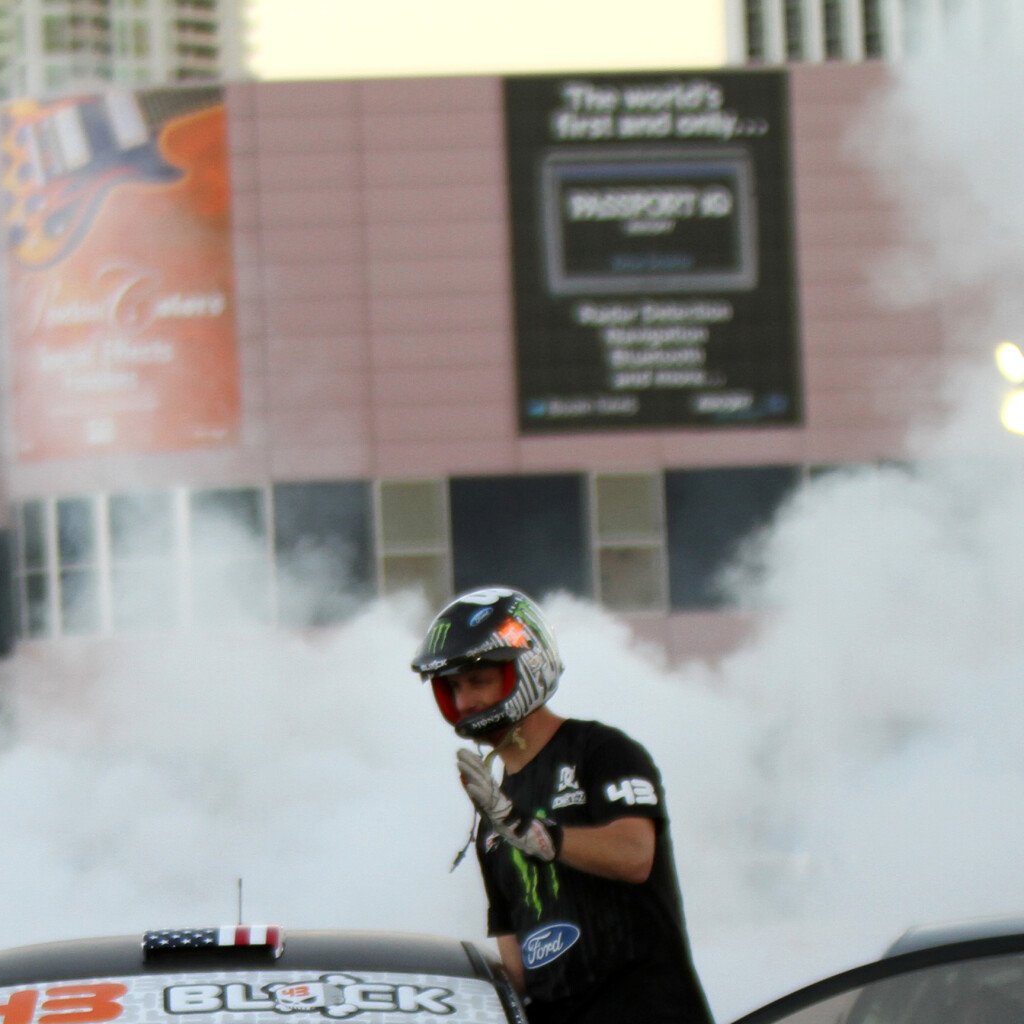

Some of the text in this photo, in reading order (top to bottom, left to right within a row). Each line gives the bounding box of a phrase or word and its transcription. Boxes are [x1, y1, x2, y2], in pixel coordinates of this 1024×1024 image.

[564, 79, 723, 112] The world's
[553, 111, 614, 139] first
[617, 111, 674, 138] and
[607, 778, 658, 806] 43
[527, 930, 565, 964] Ford
